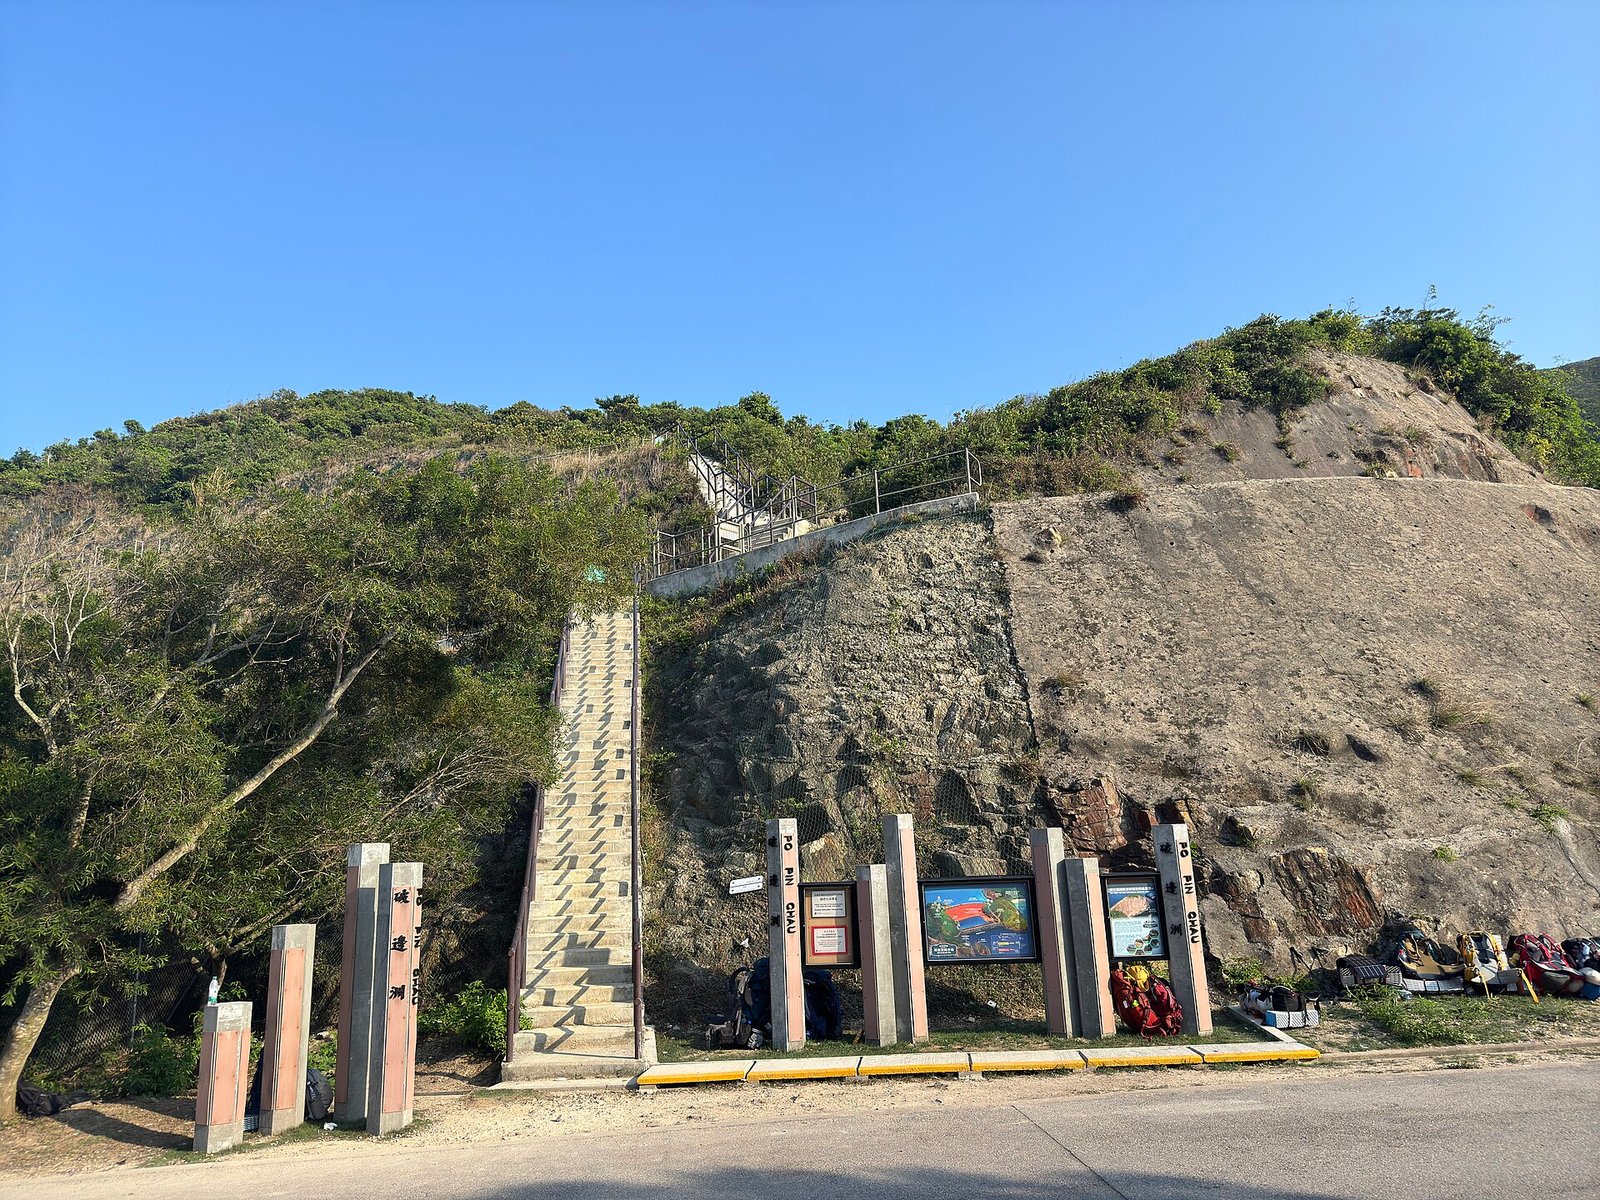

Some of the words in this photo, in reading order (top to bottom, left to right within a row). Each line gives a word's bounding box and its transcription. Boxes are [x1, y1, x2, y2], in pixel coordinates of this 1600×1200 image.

[783, 835, 793, 851] PO
[1179, 842, 1189, 858] PO
[785, 867, 794, 886] PIN
[1183, 875, 1194, 894] PIN
[786, 902, 796, 934] CHAU
[1187, 911, 1200, 944] CHAU
[389, 889, 410, 1000] 破邊洲
